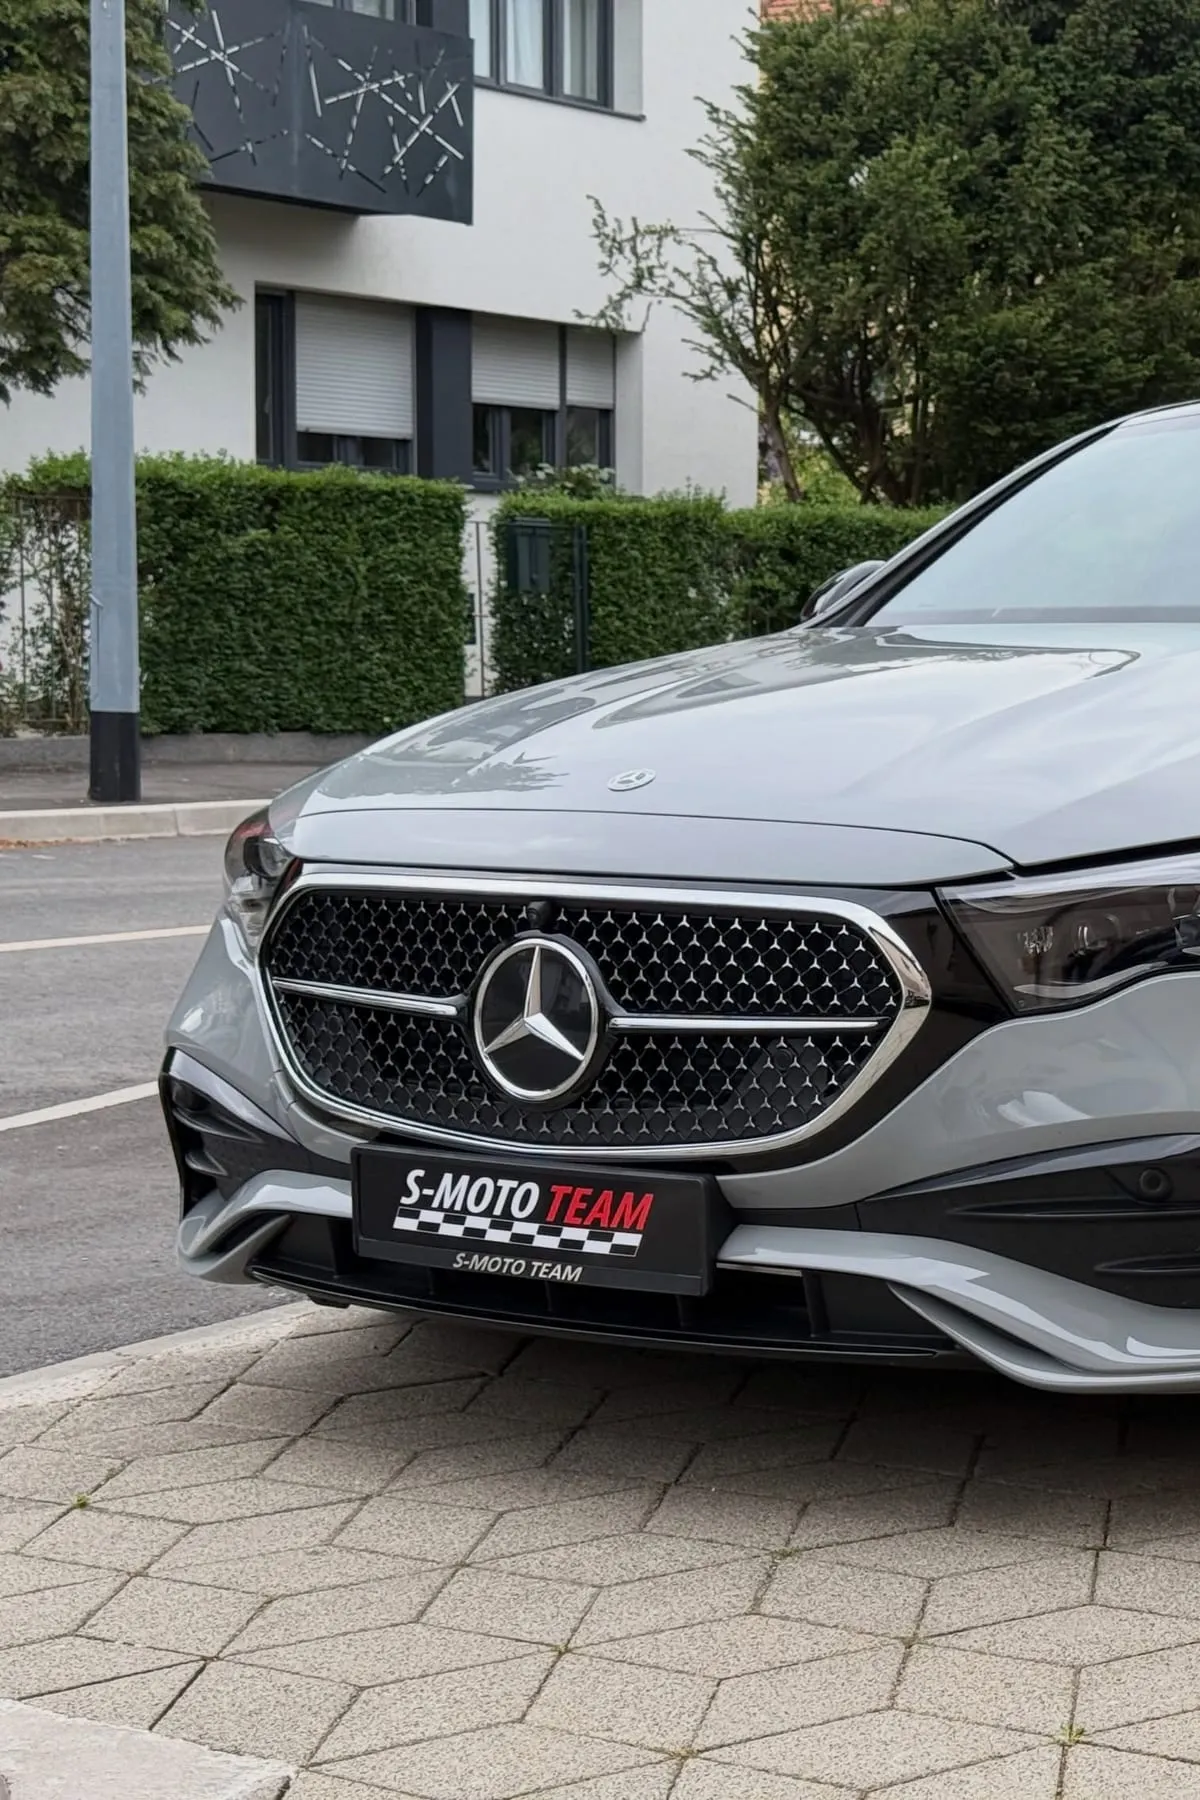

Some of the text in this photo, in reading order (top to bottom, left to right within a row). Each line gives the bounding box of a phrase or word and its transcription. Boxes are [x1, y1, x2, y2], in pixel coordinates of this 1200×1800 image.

[400, 1169, 654, 1230] S-MOTO TEAM
[453, 1252, 583, 1282] S-MOTO TEAM
